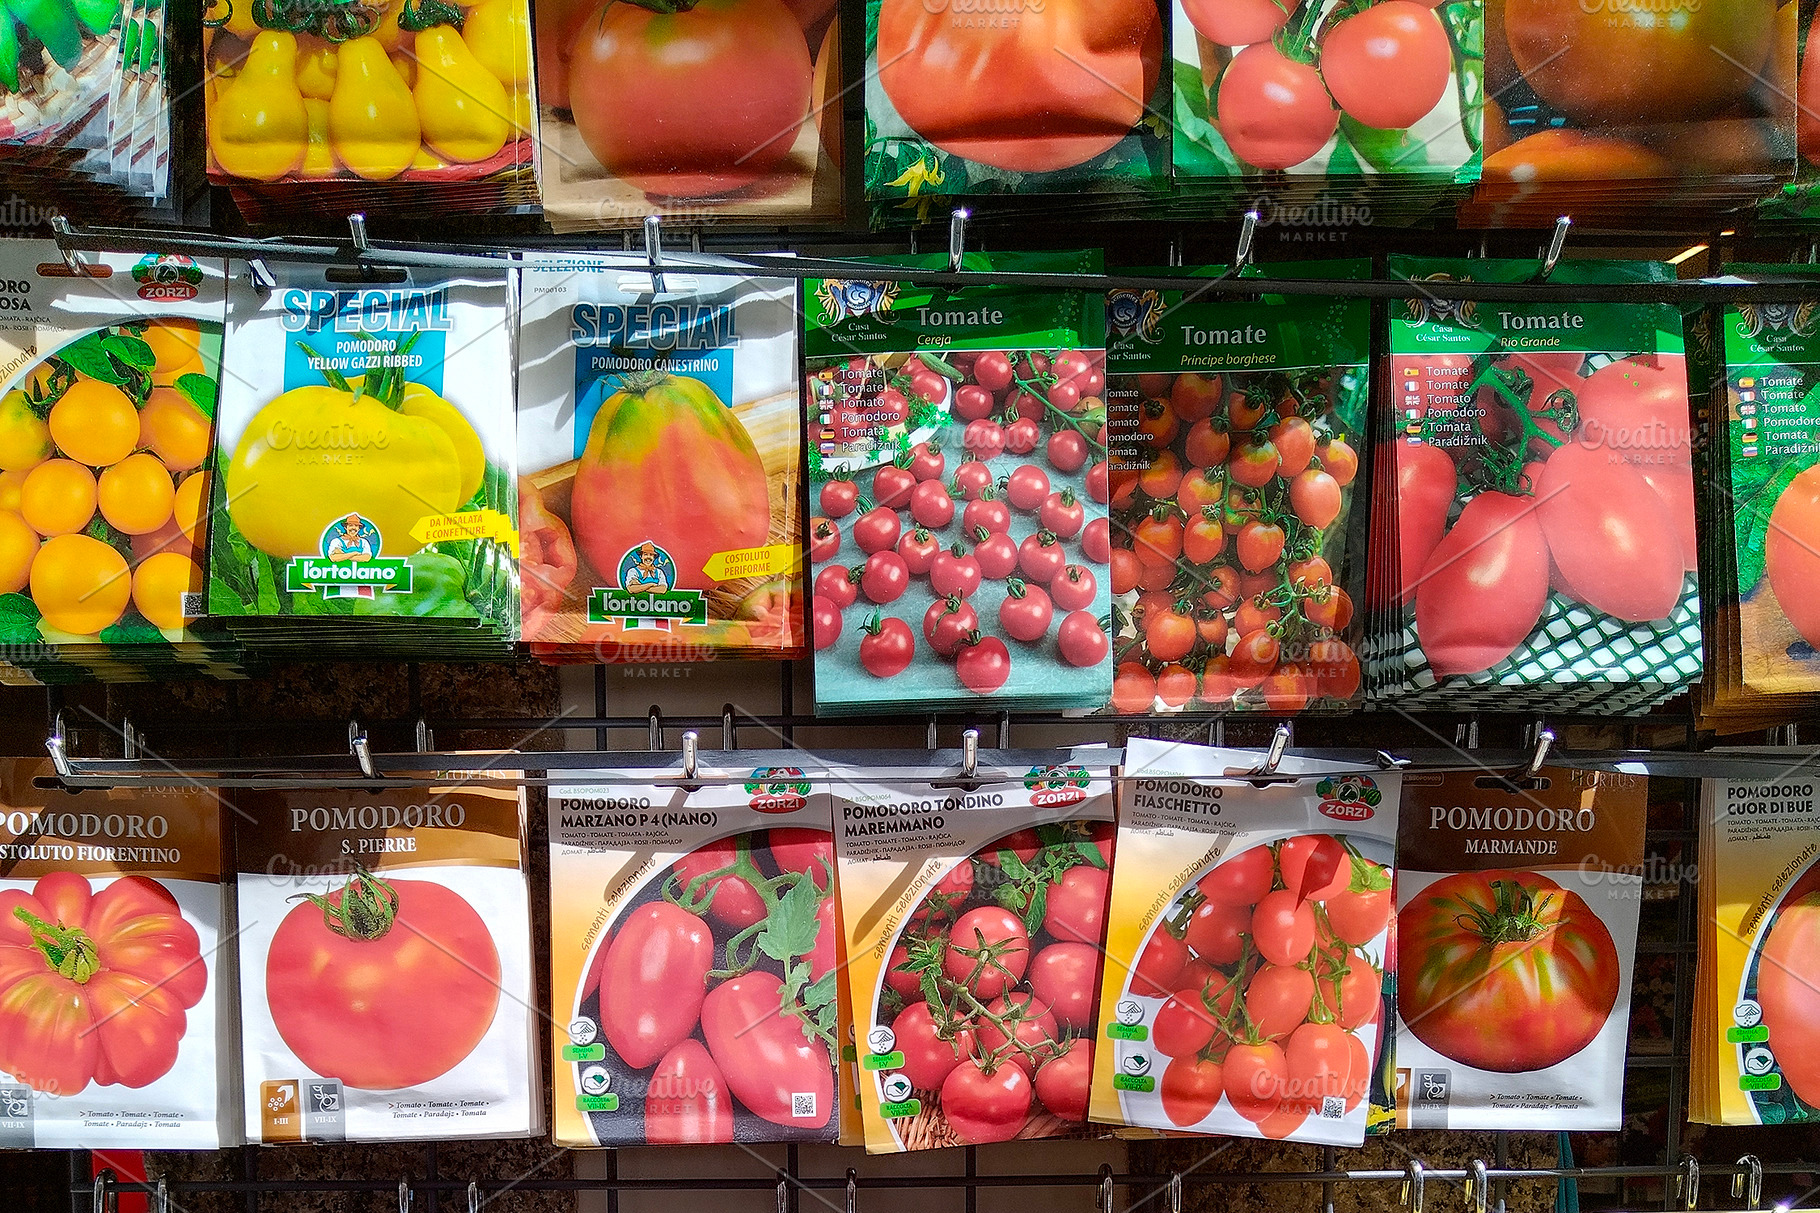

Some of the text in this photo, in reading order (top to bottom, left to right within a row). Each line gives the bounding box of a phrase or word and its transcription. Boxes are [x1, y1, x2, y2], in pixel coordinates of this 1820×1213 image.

[146, 287, 190, 297] ZORZI
[280, 289, 454, 333] SPECIAL
[917, 306, 1003, 327] Tomate
[570, 301, 740, 350] SPECIAL
[1498, 312, 1584, 330] Tomate
[917, 334, 952, 347] Cereja
[1181, 324, 1267, 345] Tomate
[1501, 336, 1560, 347] Rio Grande
[336, 340, 396, 354] POMODORO
[307, 354, 422, 369] YELLOW GAZZI RIBBED
[592, 356, 719, 373] POMODORO CANESTRINO
[840, 370, 883, 379] Tomate
[1425, 366, 1469, 376] Tomate
[840, 383, 884, 393] Tomate
[1425, 380, 1470, 390] Tomate
[1760, 377, 1803, 387] Tomate
[1427, 394, 1471, 404] Tomato
[1761, 390, 1804, 399] Tomate
[841, 398, 885, 407] Tomato
[841, 411, 900, 422] Pomodoro
[1428, 407, 1486, 417] Pomodoro
[725, 550, 771, 564] COSTOLUTO
[725, 562, 771, 576] PERIFORME
[1136, 780, 1224, 800] POMODORO
[1727, 784, 1813, 800] POMODORO
[560, 797, 651, 811] POMODORO
[758, 798, 799, 810] ZORZI
[843, 793, 1004, 820] POMODORO TONDINO
[1133, 795, 1221, 815] FIASCHETTO
[1326, 804, 1367, 817] ZORZI
[1727, 800, 1813, 816] CUOR DI BUE
[291, 803, 466, 832] POMODORO
[1429, 806, 1595, 832] POMODORO
[845, 817, 945, 837] MAREMMANO
[341, 837, 417, 854] S. PIERRE
[1465, 839, 1558, 855] MARMANDE
[77, 846, 180, 863] FIORENTINO
[581, 858, 656, 951] sementi selezionate
